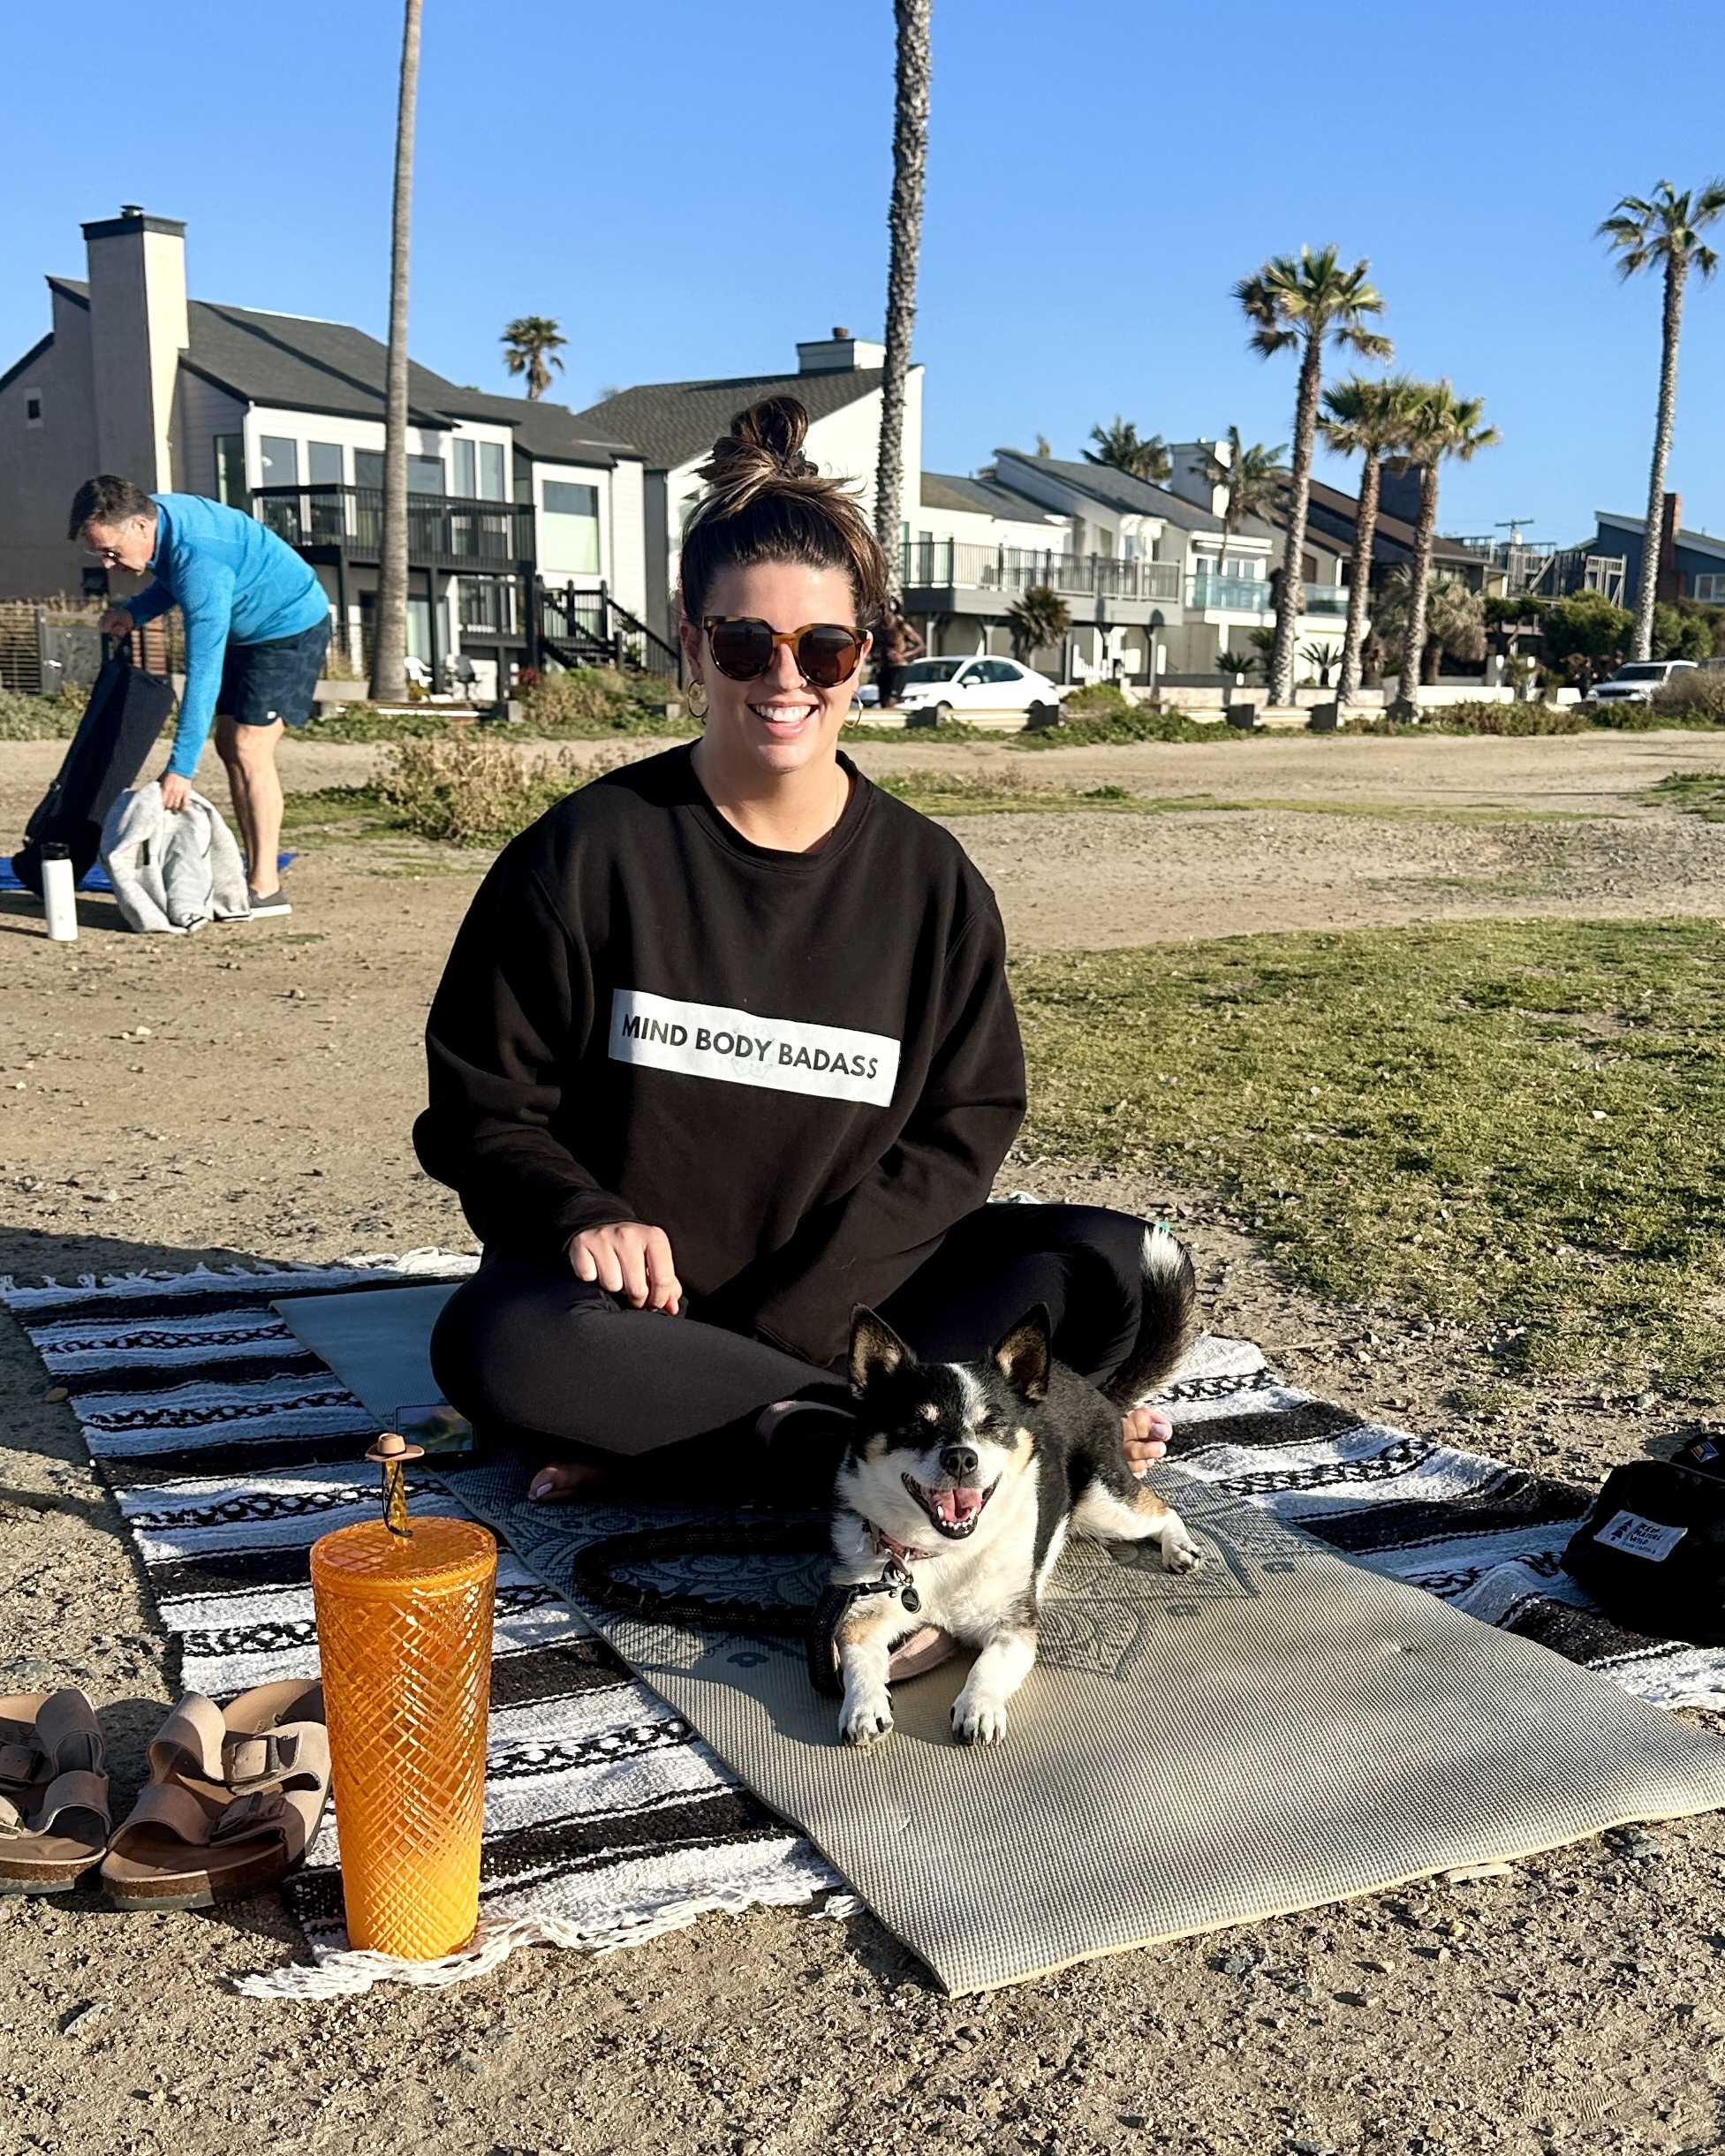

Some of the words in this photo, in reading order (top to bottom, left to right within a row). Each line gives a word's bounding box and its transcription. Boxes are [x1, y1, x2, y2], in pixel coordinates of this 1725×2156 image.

[622, 1013, 687, 1047] MIND
[695, 1028, 772, 1061] BODY
[778, 1043, 878, 1078] BADASS
[1629, 1535, 1649, 1545] WILD
[1633, 1529, 1663, 1540] NATURE
